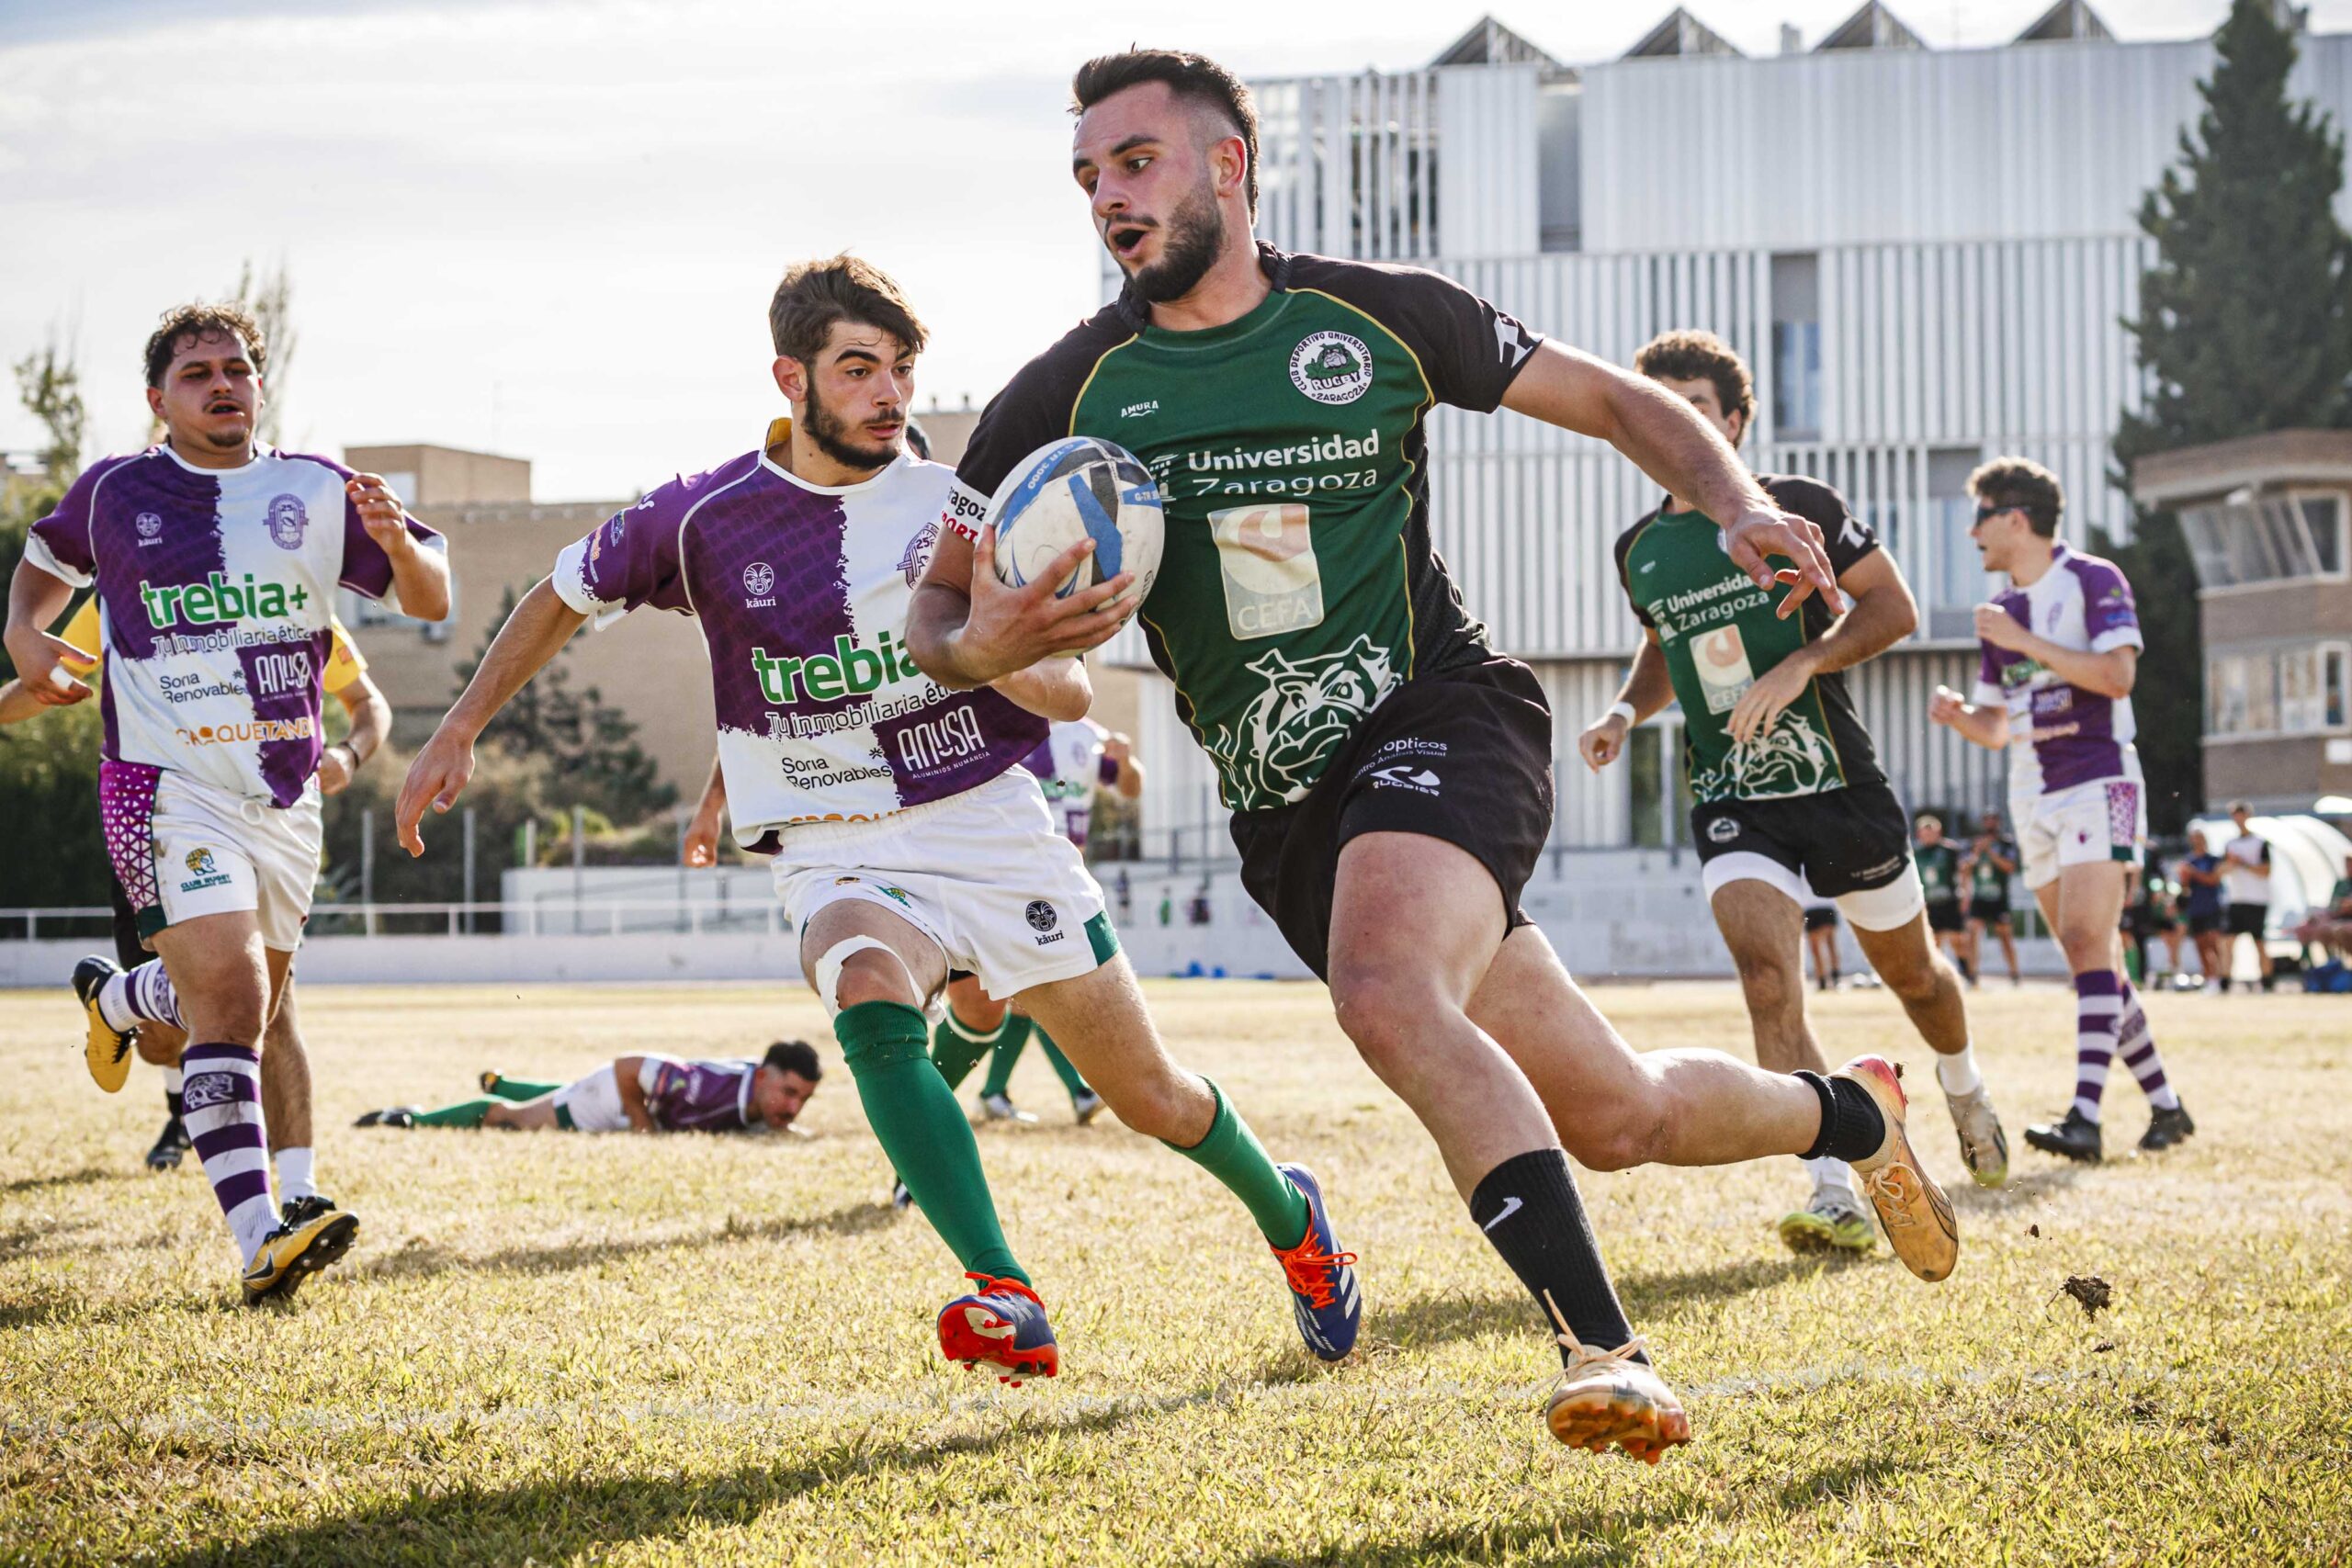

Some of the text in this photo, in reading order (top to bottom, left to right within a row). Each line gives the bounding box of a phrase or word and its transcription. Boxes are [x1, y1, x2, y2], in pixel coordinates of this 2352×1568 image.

[1291, 332, 1372, 390] CLUB DEPORTIVO UNIVERSITARIO
[1311, 371, 1361, 390] RUGBY
[1317, 385, 1366, 401] ZARAGOZA
[1121, 400, 1159, 418] AMURA
[1188, 429, 1379, 472] Universidad
[916, 537, 930, 549] 25
[141, 572, 308, 628] trebia+
[1667, 573, 1755, 613] Universida
[1238, 597, 1314, 631] CEFA
[1676, 591, 1770, 631] Zaragoza
[173, 626, 277, 653] inmobiliaria
[766, 712, 789, 734] Tu
[791, 694, 922, 734] inmobiliaria
[897, 705, 986, 772] ANUSA
[786, 764, 892, 790] Renovables
[912, 752, 990, 779] ALUMINIOS NUMANCIA
